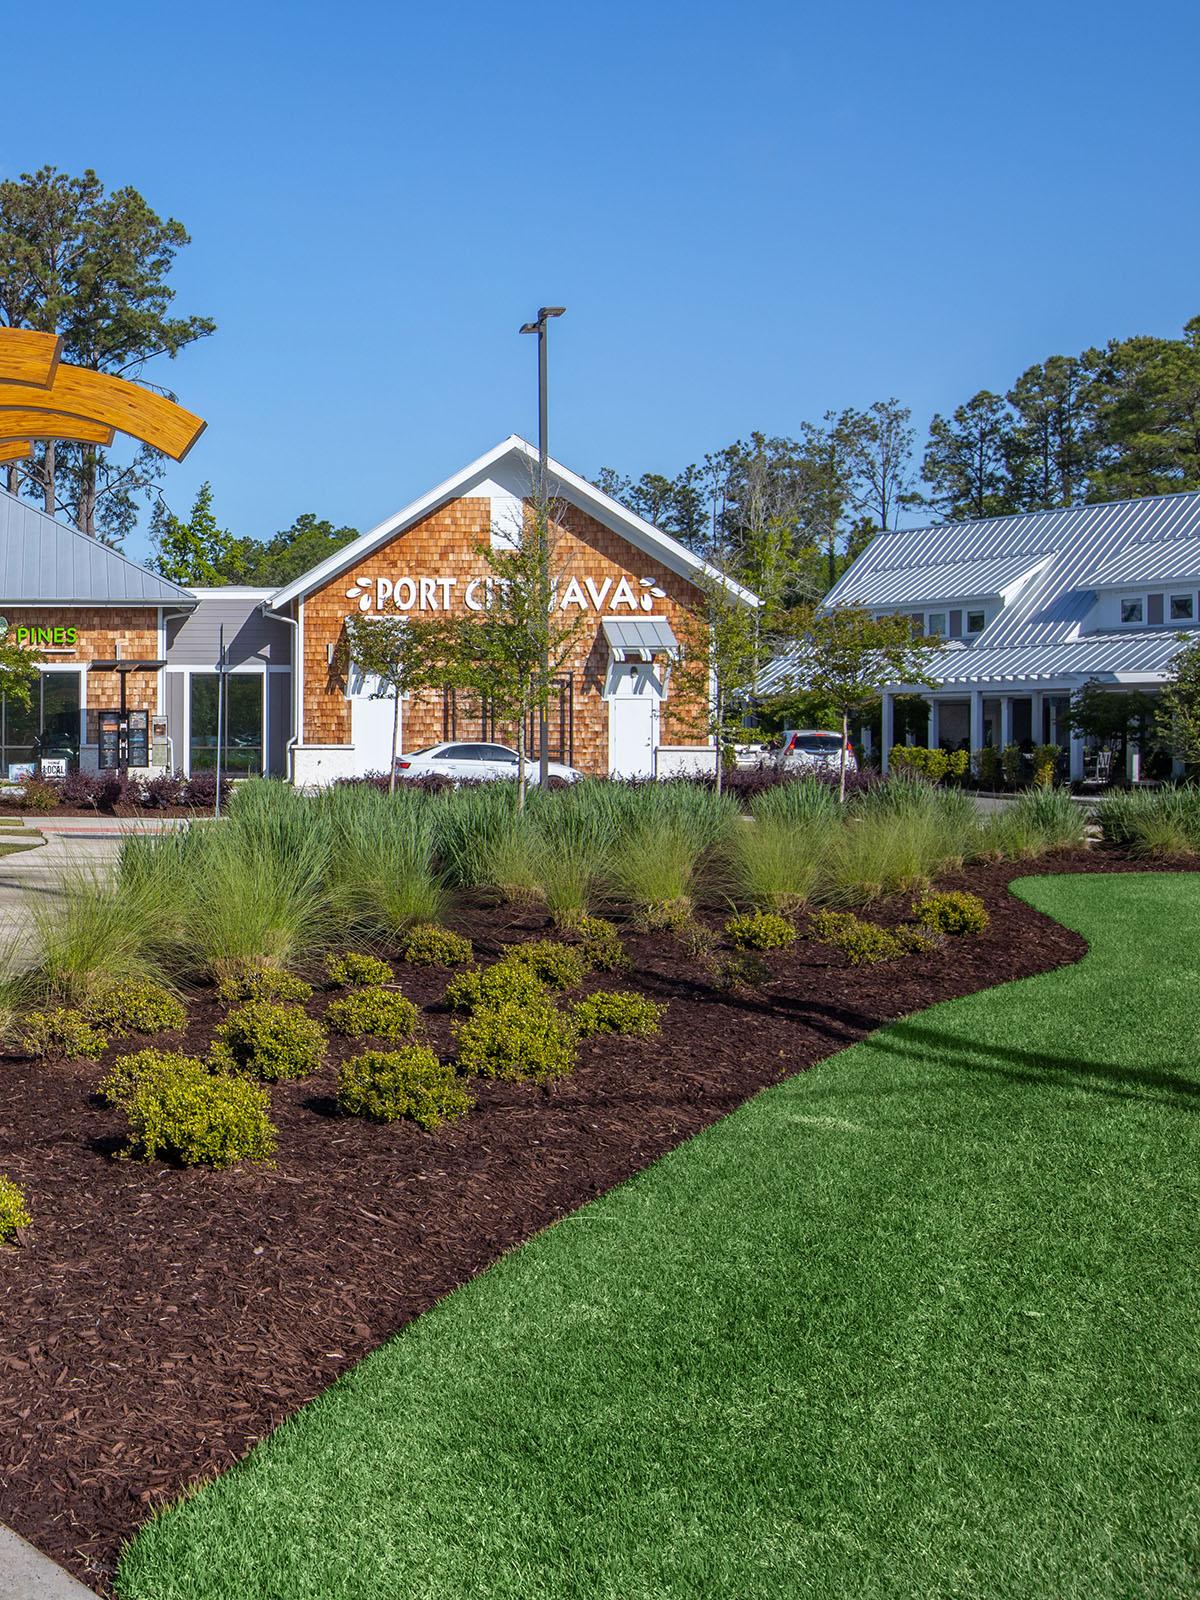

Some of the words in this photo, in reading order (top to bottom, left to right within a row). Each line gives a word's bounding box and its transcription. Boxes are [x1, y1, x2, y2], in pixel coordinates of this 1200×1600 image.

[376, 576, 457, 611] PORT
[464, 576, 534, 611] CIT
[17, 627, 78, 645] PINES
[42, 765, 65, 775] LOCAL
